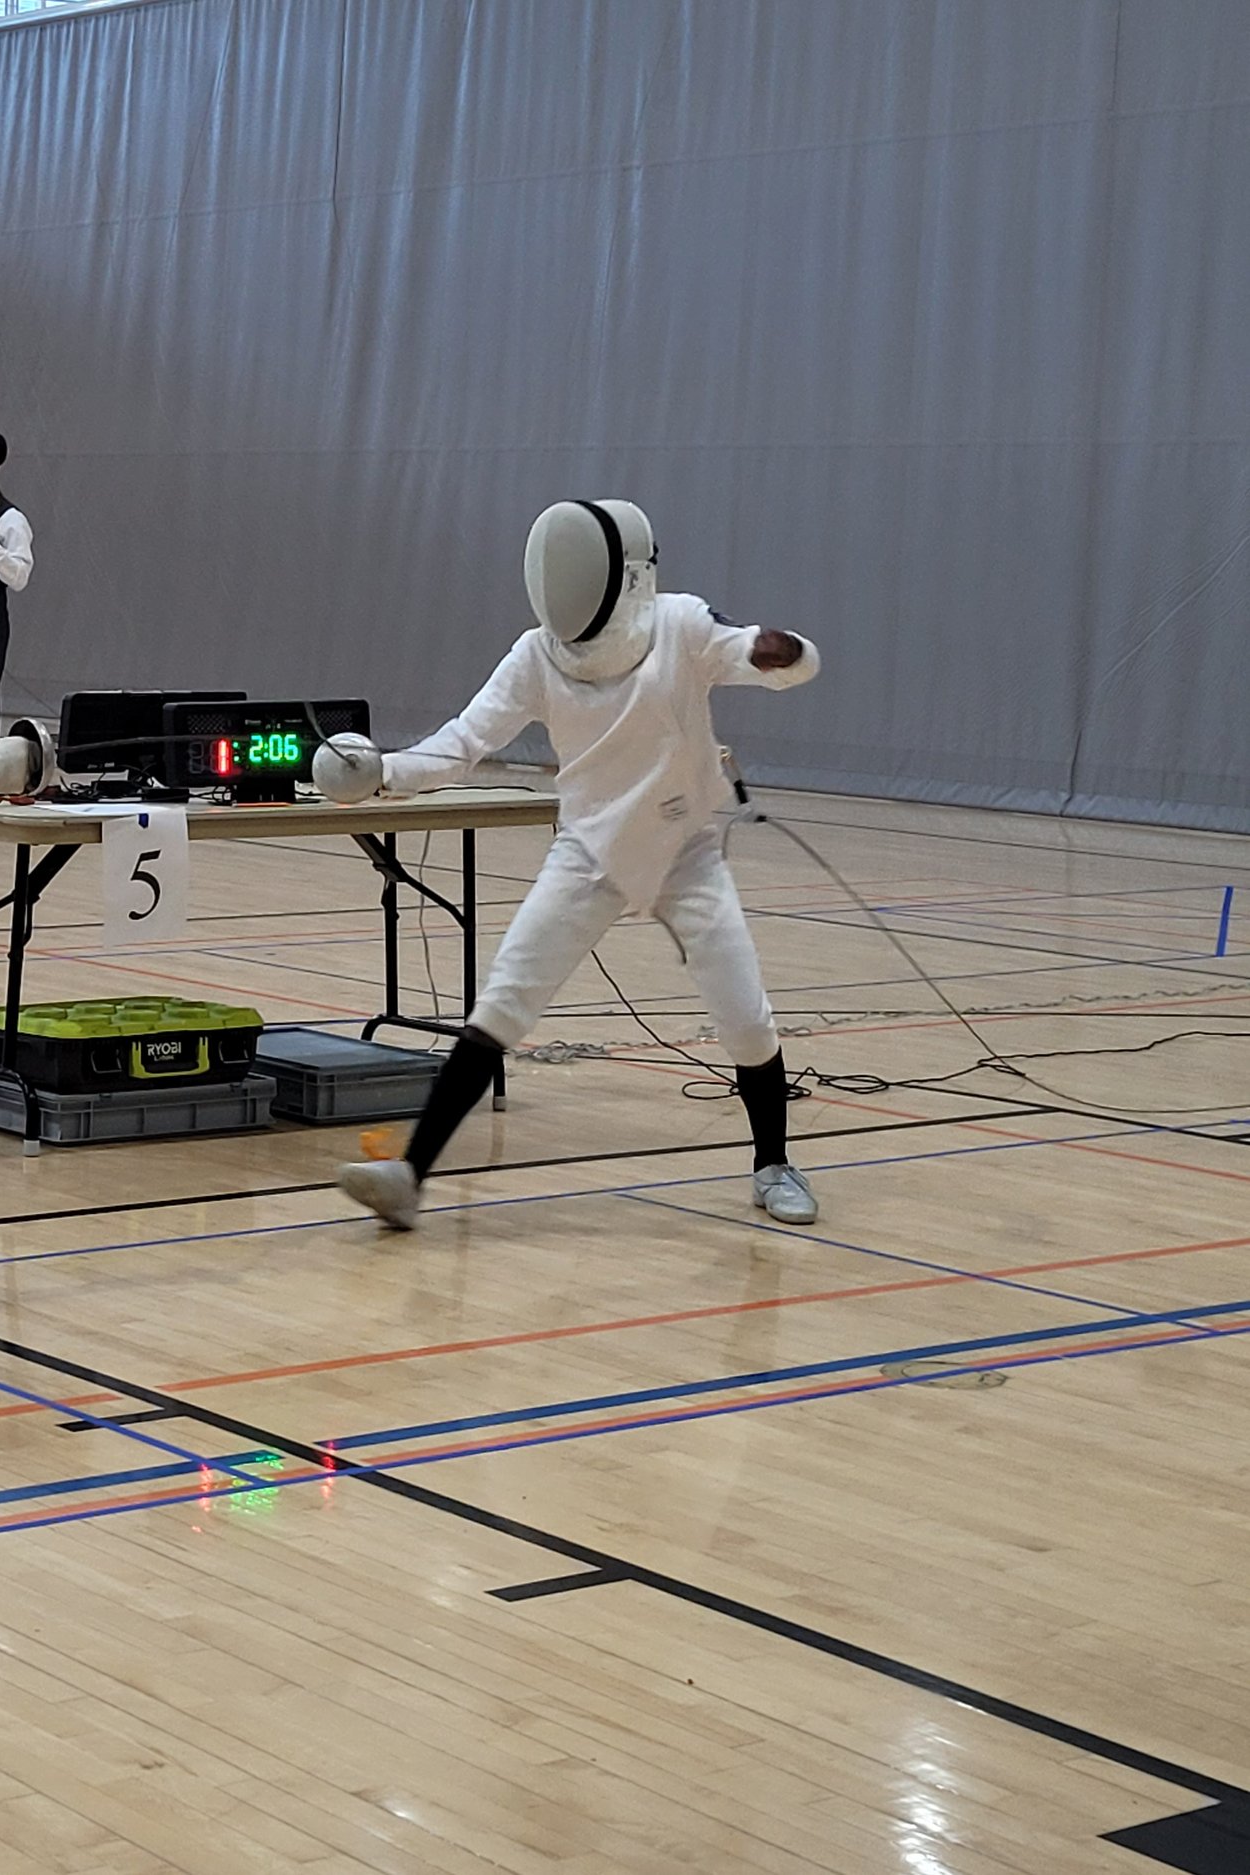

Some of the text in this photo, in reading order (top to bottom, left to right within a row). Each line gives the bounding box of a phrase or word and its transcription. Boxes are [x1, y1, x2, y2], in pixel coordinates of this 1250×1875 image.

[248, 733, 300, 763] 2:06
[128, 849, 162, 920] 5
[146, 1041, 182, 1057] RYOBI
